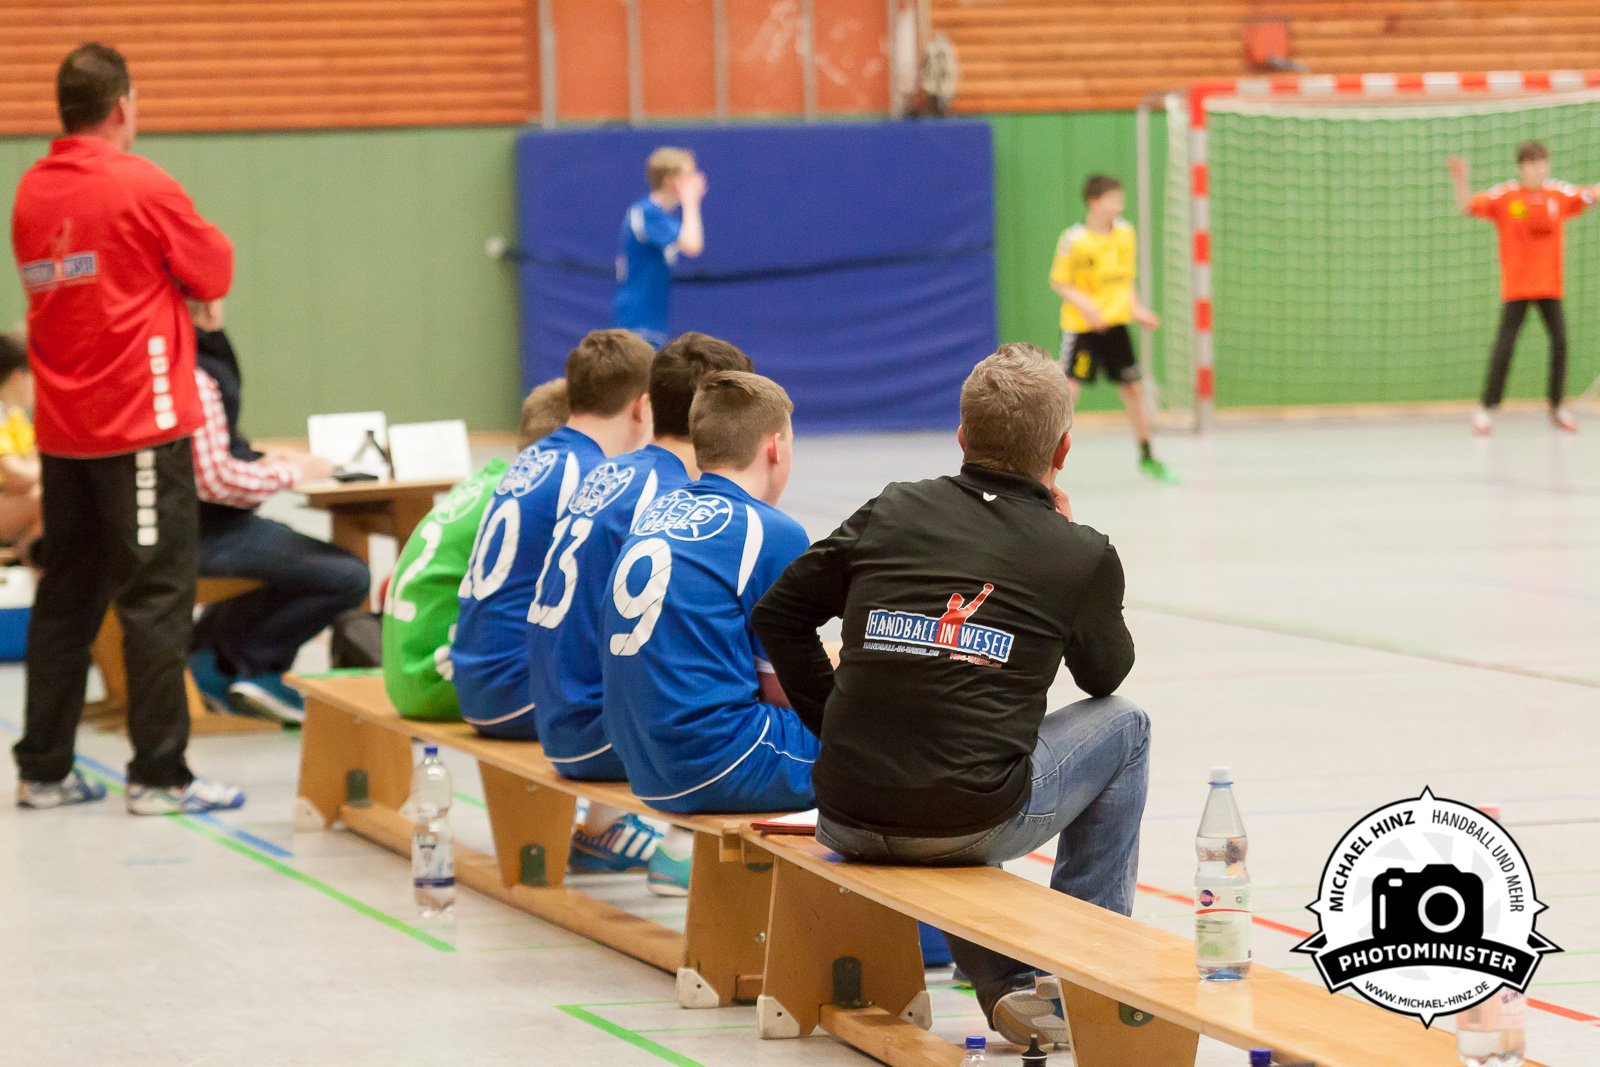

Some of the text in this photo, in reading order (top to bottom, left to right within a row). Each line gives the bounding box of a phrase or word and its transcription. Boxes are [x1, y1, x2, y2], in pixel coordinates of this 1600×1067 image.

[527, 514, 593, 629] 13
[610, 537, 673, 656] 9
[867, 614, 1008, 658] HANDBALL IN WESEL
